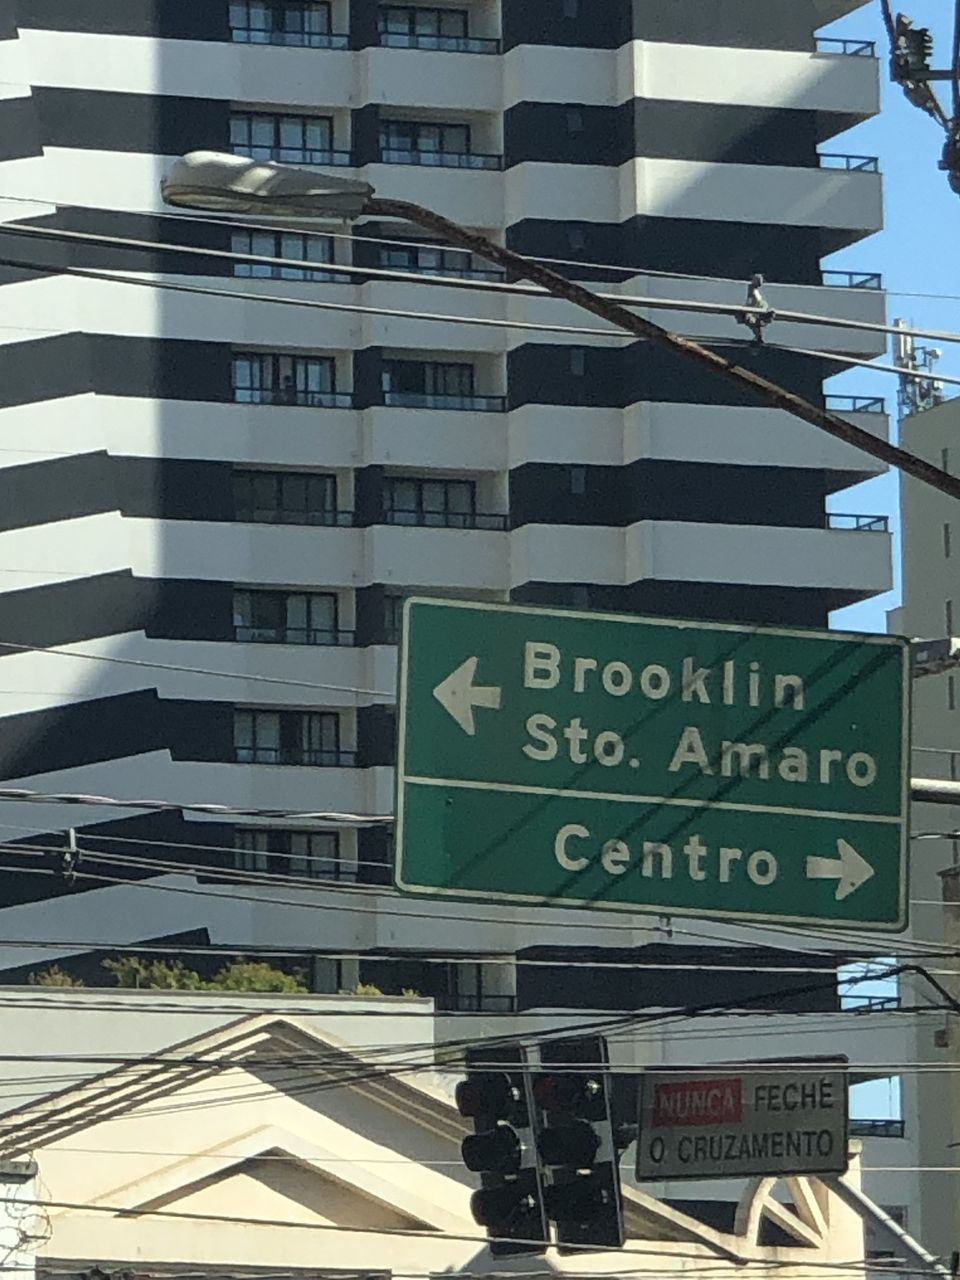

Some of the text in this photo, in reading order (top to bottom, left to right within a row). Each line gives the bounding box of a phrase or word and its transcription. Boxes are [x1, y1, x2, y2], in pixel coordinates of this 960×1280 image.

[525, 641, 805, 711] Brooklin
[522, 714, 877, 788] Sto. Amaro
[554, 824, 779, 886] Centro
[658, 1082, 834, 1118] NUNCA FECHE
[649, 1129, 833, 1164] O CRUZAMENTO
